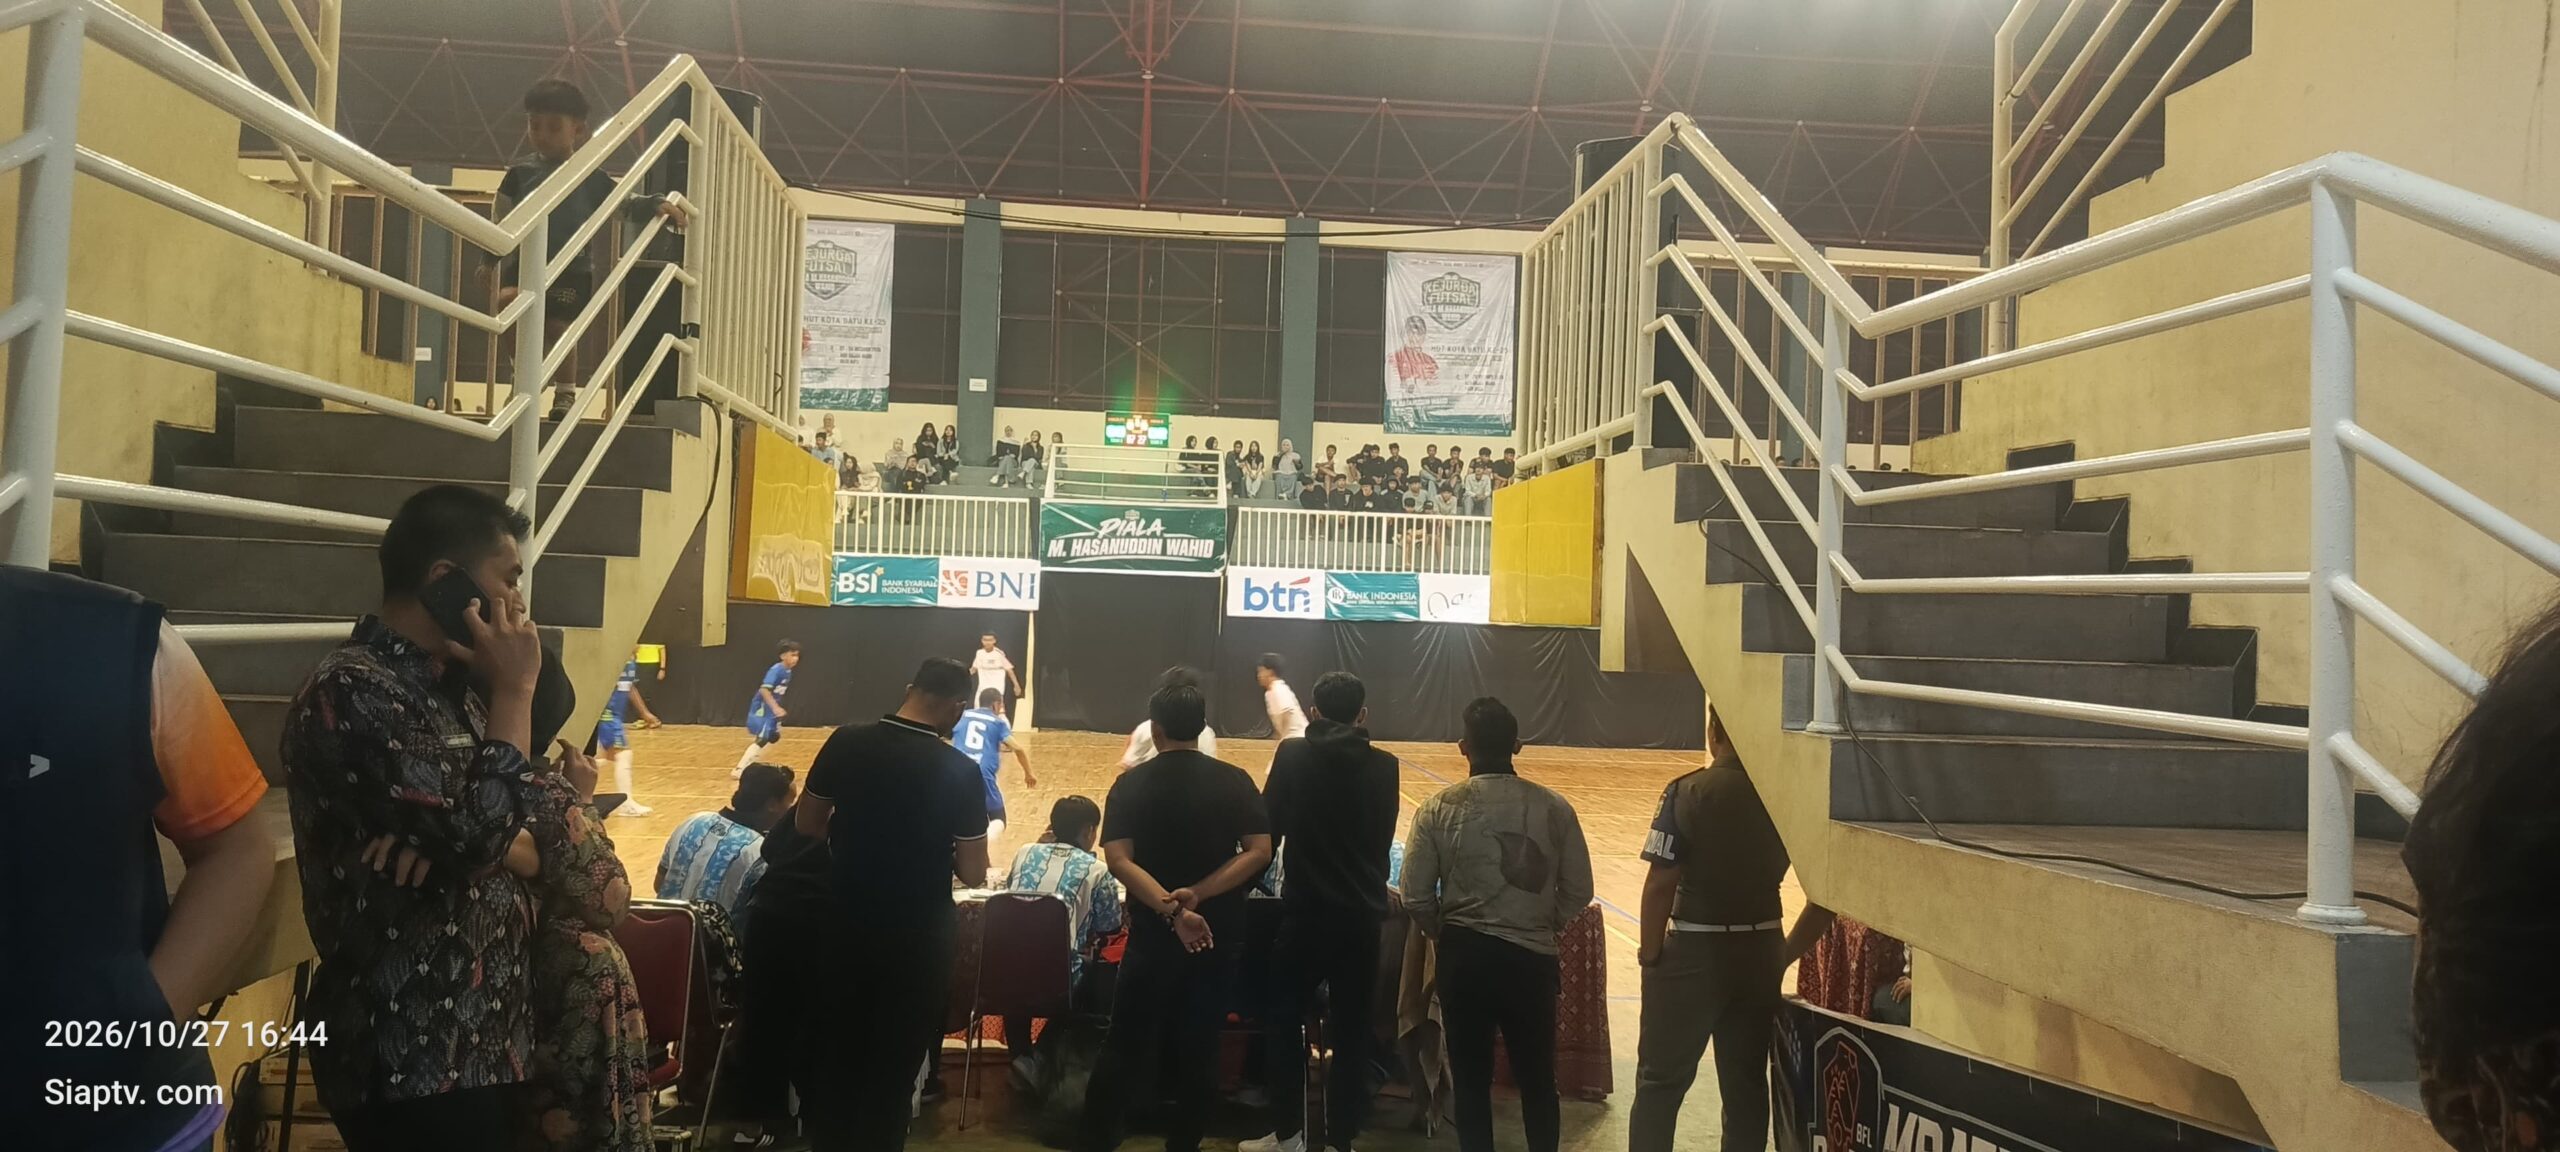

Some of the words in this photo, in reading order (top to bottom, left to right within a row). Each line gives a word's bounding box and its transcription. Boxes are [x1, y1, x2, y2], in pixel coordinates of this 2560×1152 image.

[1429, 292, 1475, 305] FUTSAL
[1097, 518, 1167, 539] PIALA
[1047, 539, 1067, 558] M.
[1070, 537, 1164, 557] HASANUDDIN
[1166, 538, 1215, 559] WAHID
[838, 572, 878, 593] BSI
[881, 579, 904, 587] BANK
[881, 586, 924, 594] INDONESIA
[974, 571, 1036, 599] BNI
[1244, 577, 1311, 612] btn
[1346, 591, 1370, 600] BANK
[1371, 591, 1417, 601] INDONESIA
[964, 720, 987, 750] 6
[1855, 1123, 1872, 1149] BFL
